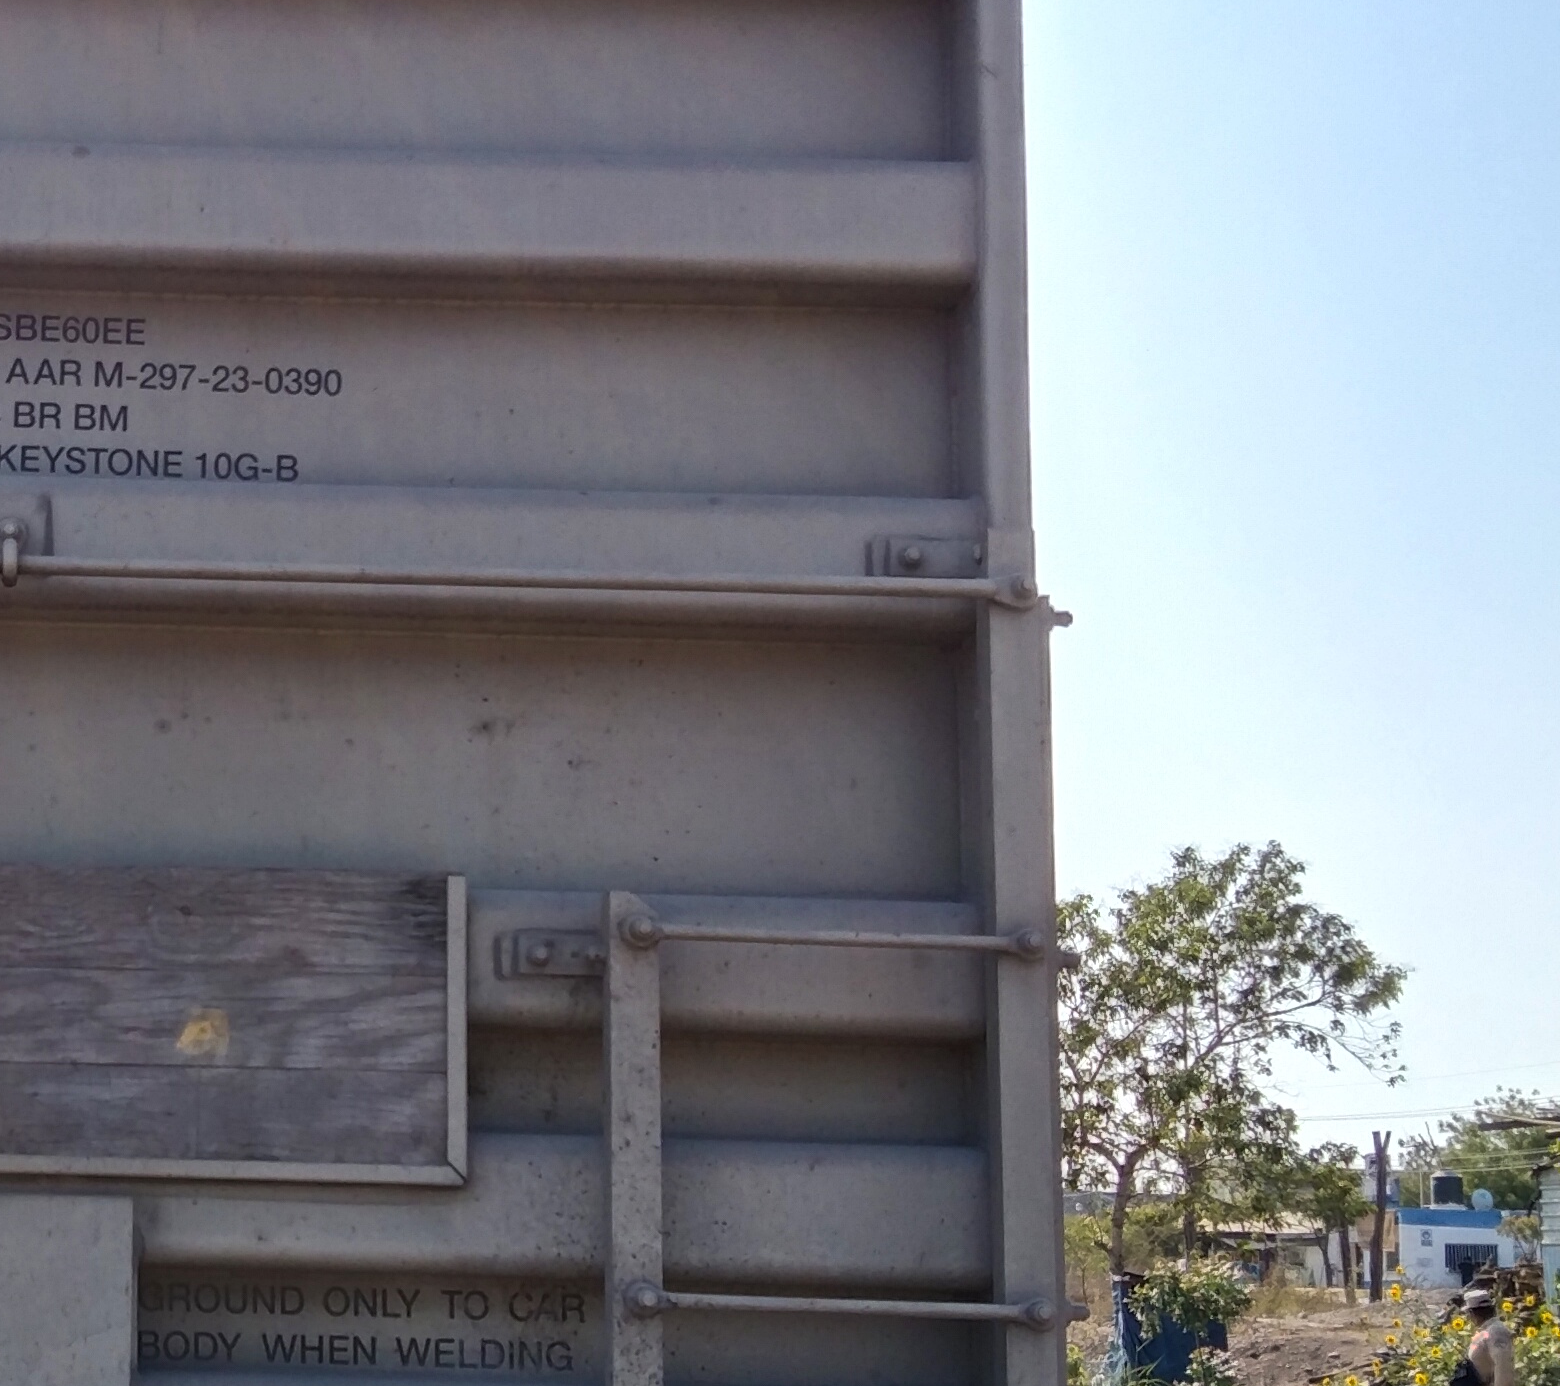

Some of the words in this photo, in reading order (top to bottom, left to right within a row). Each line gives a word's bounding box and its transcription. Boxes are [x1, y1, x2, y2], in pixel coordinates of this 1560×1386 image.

[5, 358, 82, 387] AAR
[94, 361, 343, 397] M-297-23-0390
[13, 402, 62, 429] BR
[74, 404, 129, 432] BM
[195, 453, 299, 483] 10G-B
[139, 1282, 304, 1316] GROUND
[323, 1287, 421, 1318] ONLY
[441, 1290, 489, 1320] TO
[509, 1290, 585, 1323] CAR
[139, 1331, 241, 1362] BODY
[263, 1333, 377, 1366] WHEN
[396, 1336, 574, 1371] WELDING
